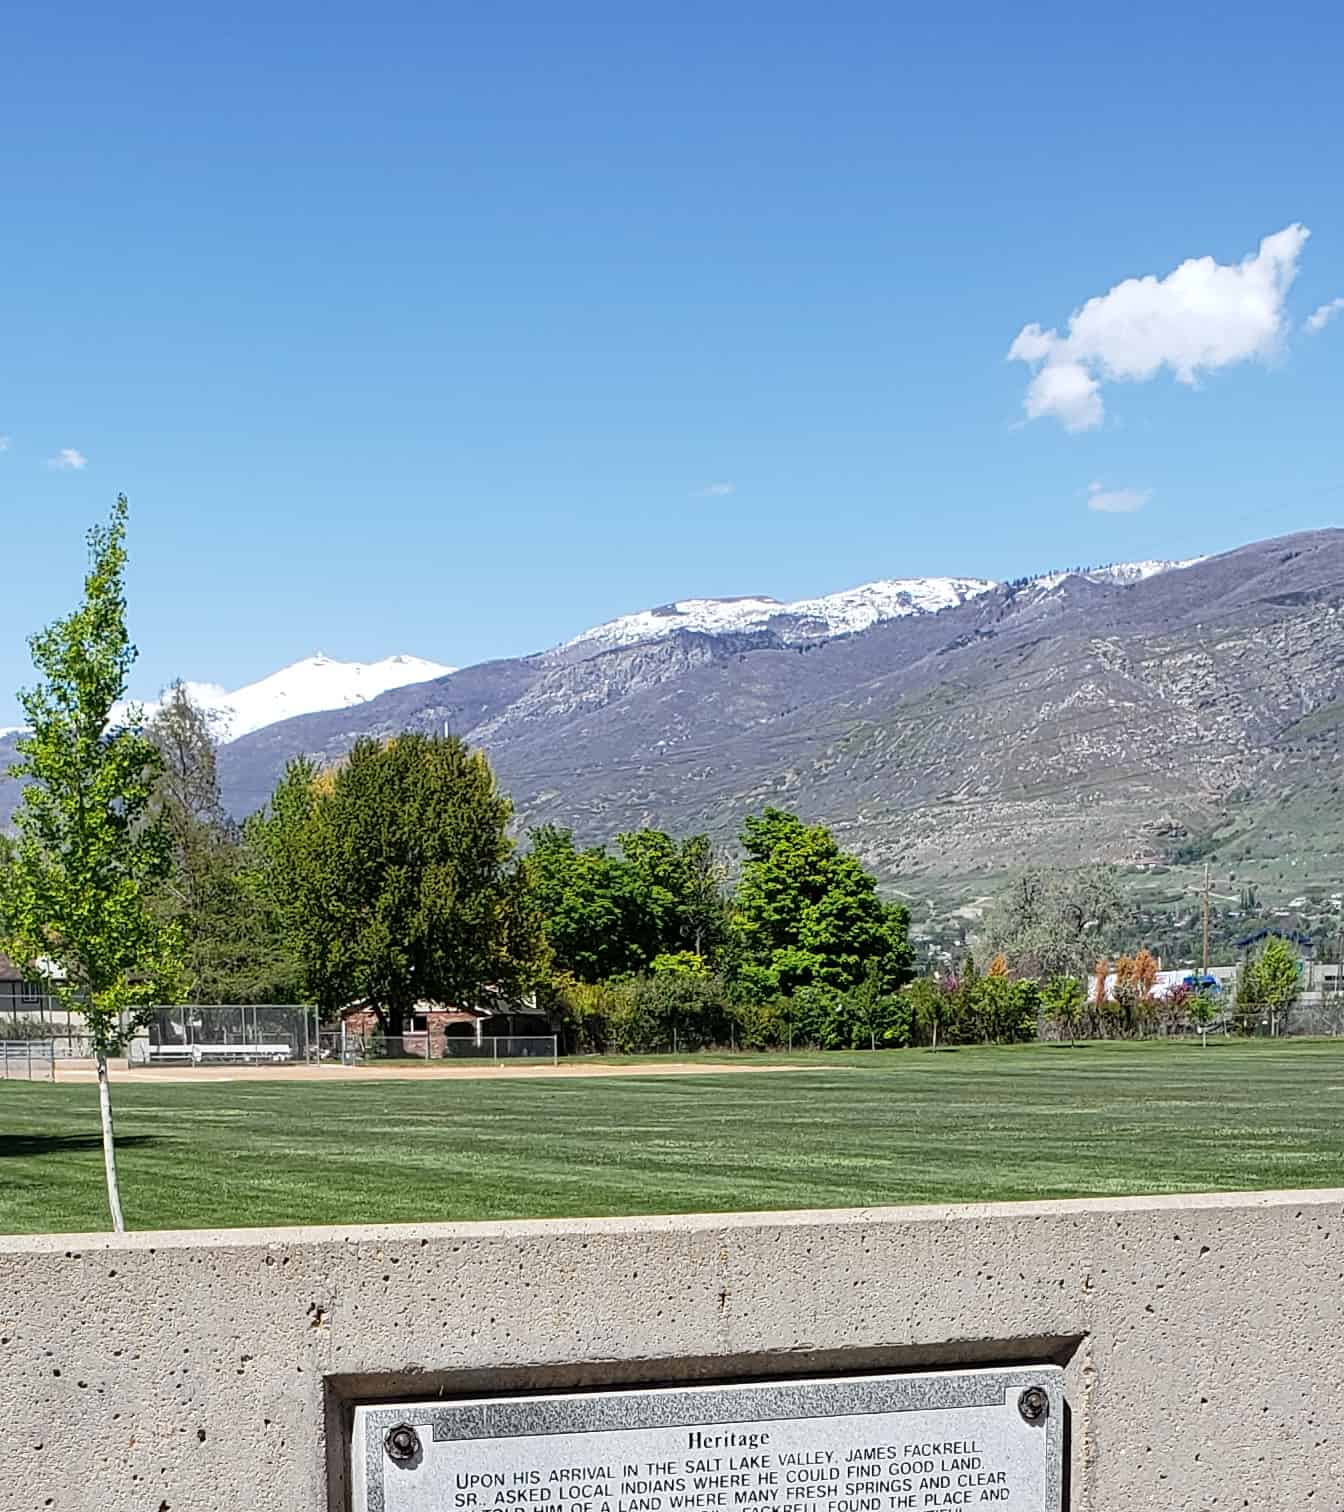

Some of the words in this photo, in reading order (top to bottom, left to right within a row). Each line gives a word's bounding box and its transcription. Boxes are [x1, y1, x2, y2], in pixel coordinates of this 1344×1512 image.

[688, 1431, 770, 1450] Heritage
[513, 1470, 541, 1485] HIS
[548, 1466, 616, 1483] ARRIVAL
[623, 1464, 639, 1478] IN
[645, 1461, 677, 1476] THE
[685, 1458, 723, 1474] SALT
[729, 1454, 771, 1471] LAKE
[844, 1445, 897, 1462] JAMES
[903, 1440, 983, 1457] FACKRELL
[618, 1497, 662, 1512] LAND
[669, 1492, 727, 1509] WHERE
[734, 1488, 779, 1505] MANY
[786, 1484, 838, 1500] FRESH
[845, 1478, 913, 1496] SPRINGS
[919, 1475, 951, 1490] AND
[957, 1471, 1007, 1488] CLEAR
[828, 1497, 881, 1512] FOUND
[888, 1494, 917, 1509] THE
[924, 1490, 973, 1507] PLACE
[979, 1487, 1010, 1502] AND
